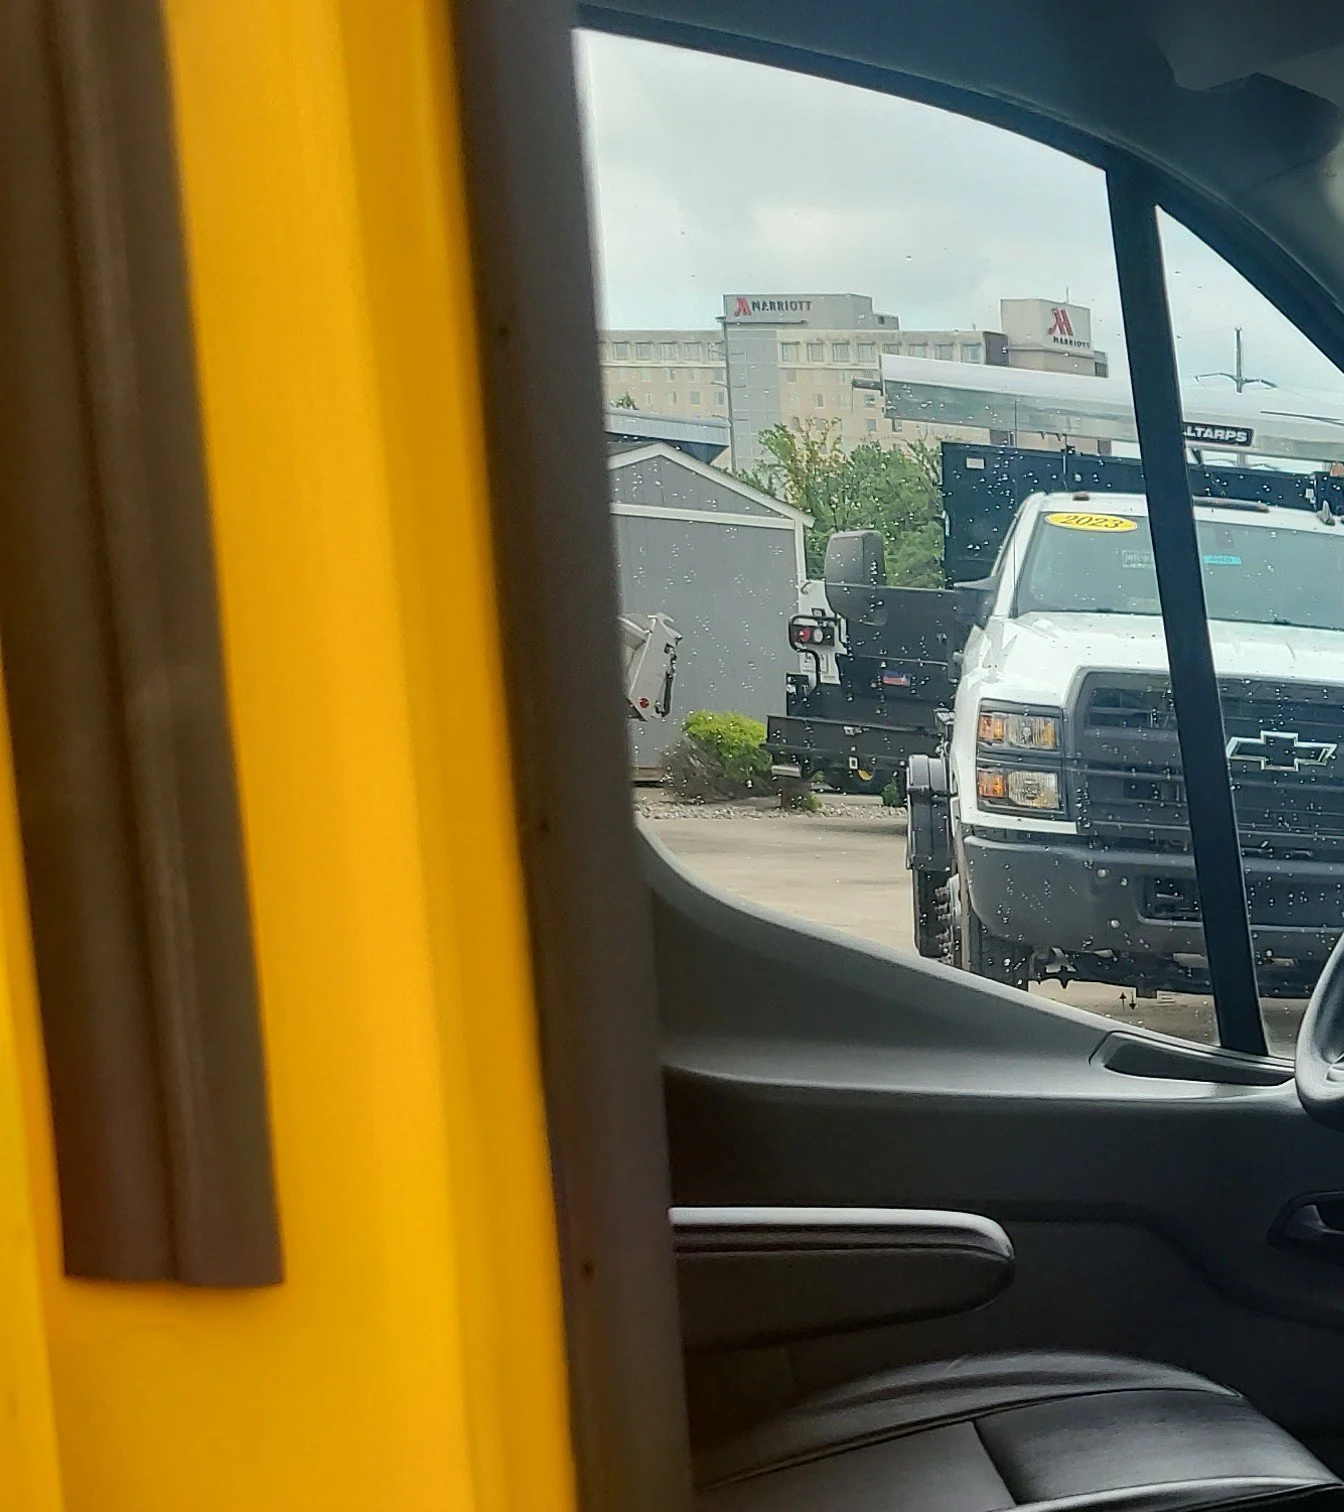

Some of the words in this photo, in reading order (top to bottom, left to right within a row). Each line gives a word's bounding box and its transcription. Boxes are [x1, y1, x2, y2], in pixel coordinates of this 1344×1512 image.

[752, 300, 811, 312] MARRIOTT
[1053, 336, 1090, 349] MARRIOTT
[1059, 515, 1124, 529] 2023
